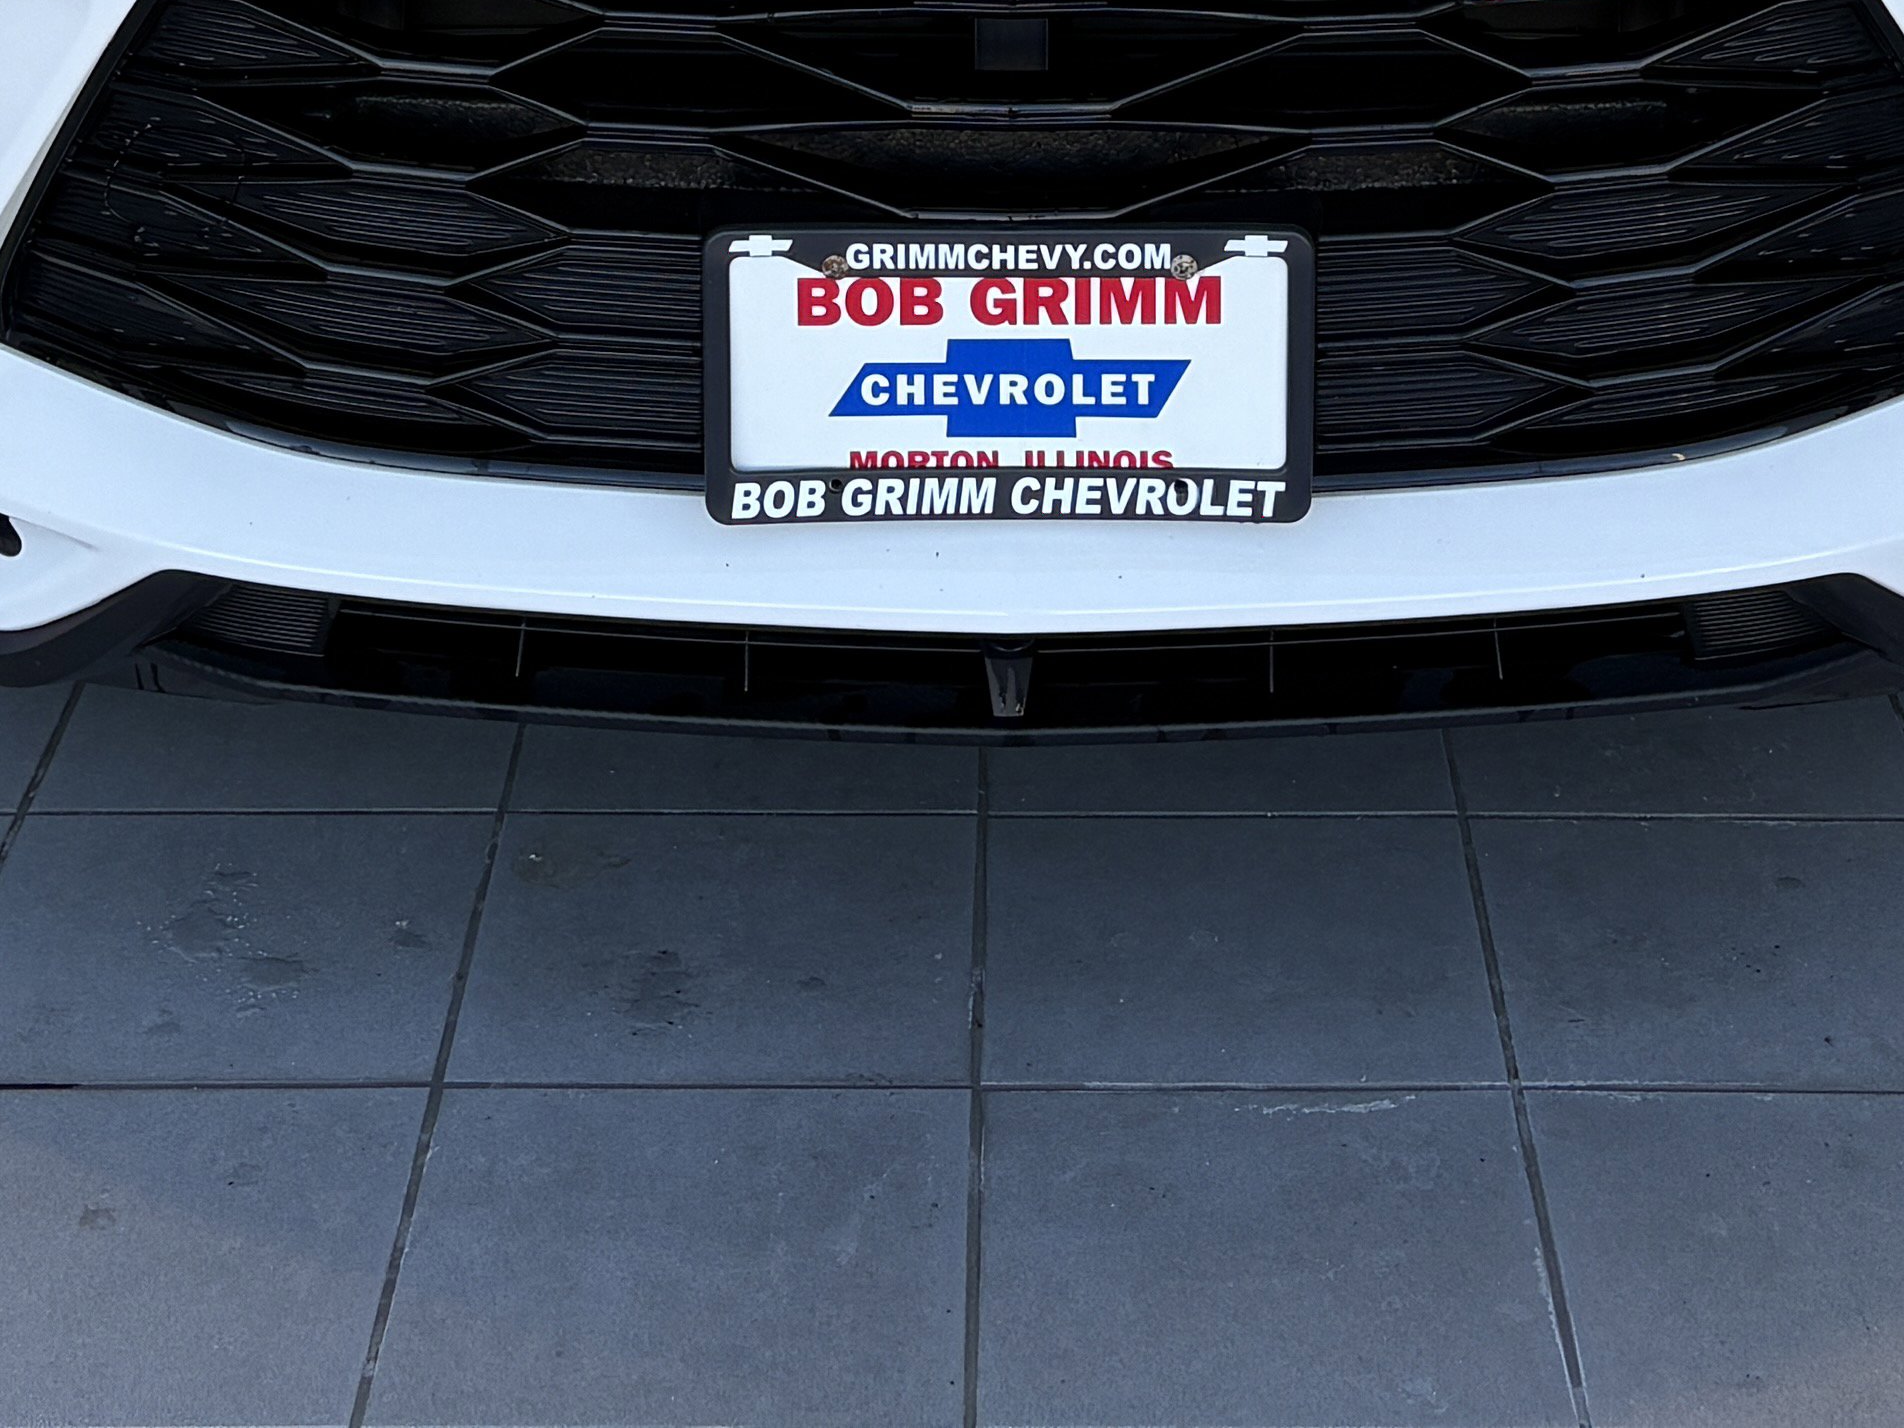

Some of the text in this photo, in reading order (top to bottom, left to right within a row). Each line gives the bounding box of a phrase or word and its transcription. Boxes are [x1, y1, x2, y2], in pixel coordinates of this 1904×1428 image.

[845, 243, 1172, 271] GRIMMCHEVY.COM
[797, 276, 1222, 327] BOB GRIMM
[860, 373, 1157, 406] CHEVROLET
[731, 477, 1286, 520] BOB GRIMM CHEVROLET
